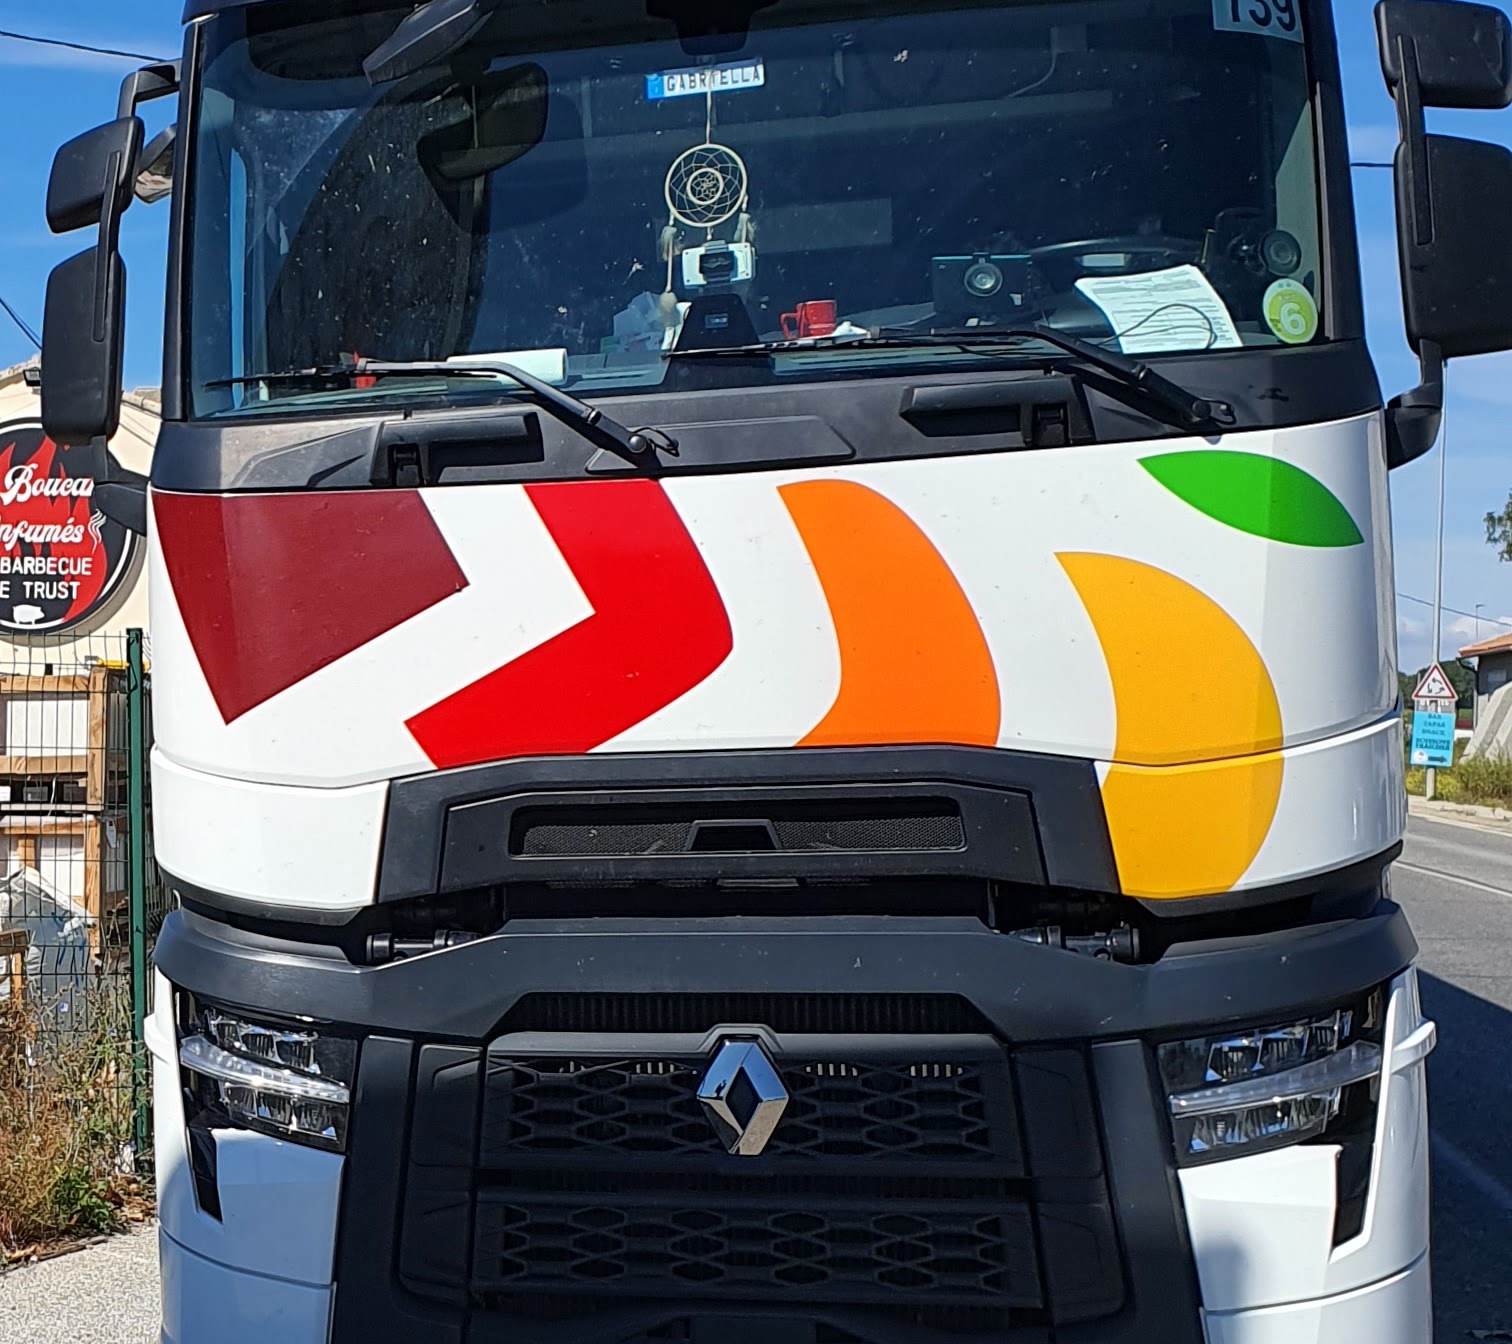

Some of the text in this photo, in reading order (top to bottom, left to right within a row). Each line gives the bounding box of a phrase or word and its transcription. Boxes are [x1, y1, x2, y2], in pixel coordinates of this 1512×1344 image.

[1280, 302, 1306, 335] 6
[0, 557, 93, 575] BARBECUE
[23, 581, 81, 599] TRUST
